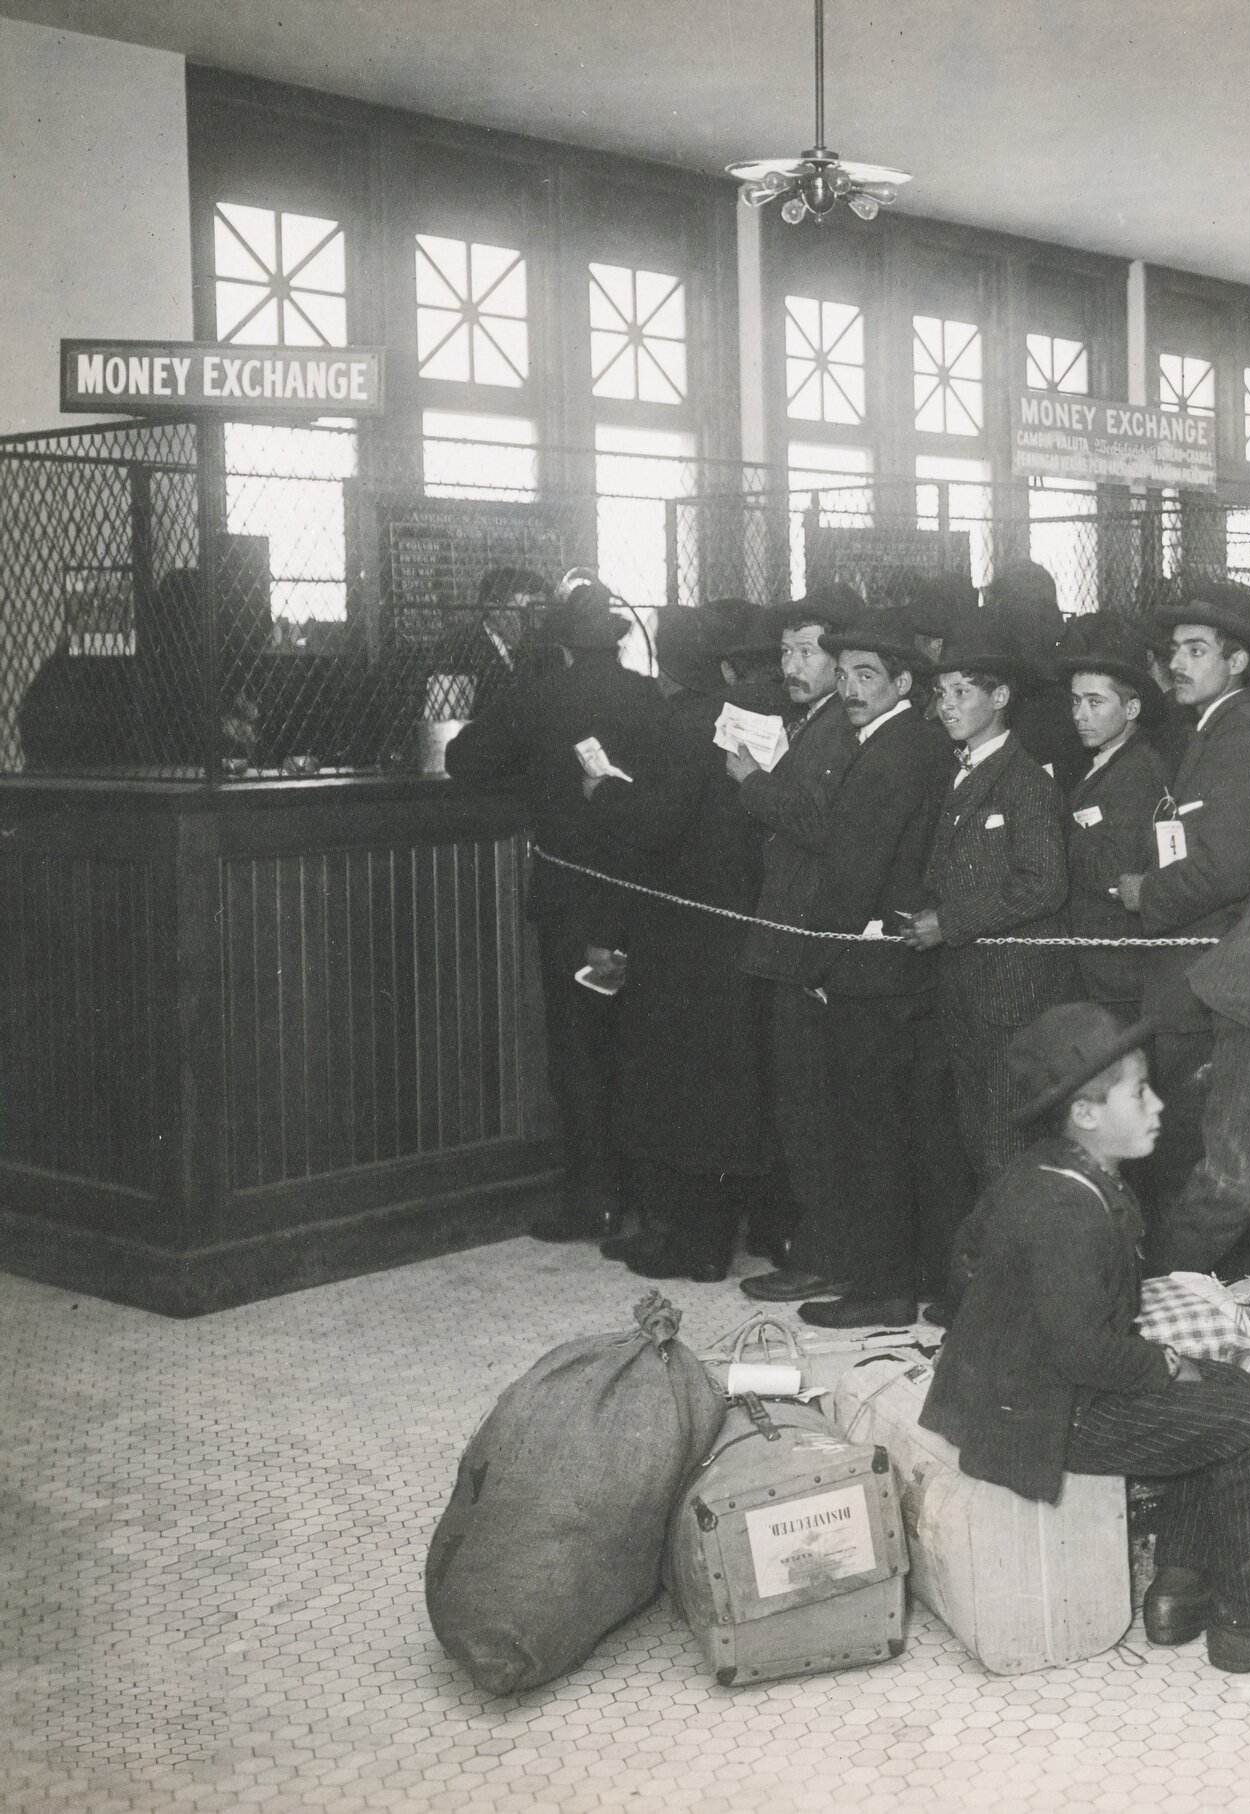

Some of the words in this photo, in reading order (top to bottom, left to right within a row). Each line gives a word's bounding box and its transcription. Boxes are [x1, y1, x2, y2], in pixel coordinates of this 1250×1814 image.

[76, 354, 191, 397] MONEY
[203, 356, 368, 402] EXCHANGE
[1020, 397, 1096, 430] MONEY
[1106, 408, 1208, 445] EXCHANGE
[1169, 834, 1177, 855] 4
